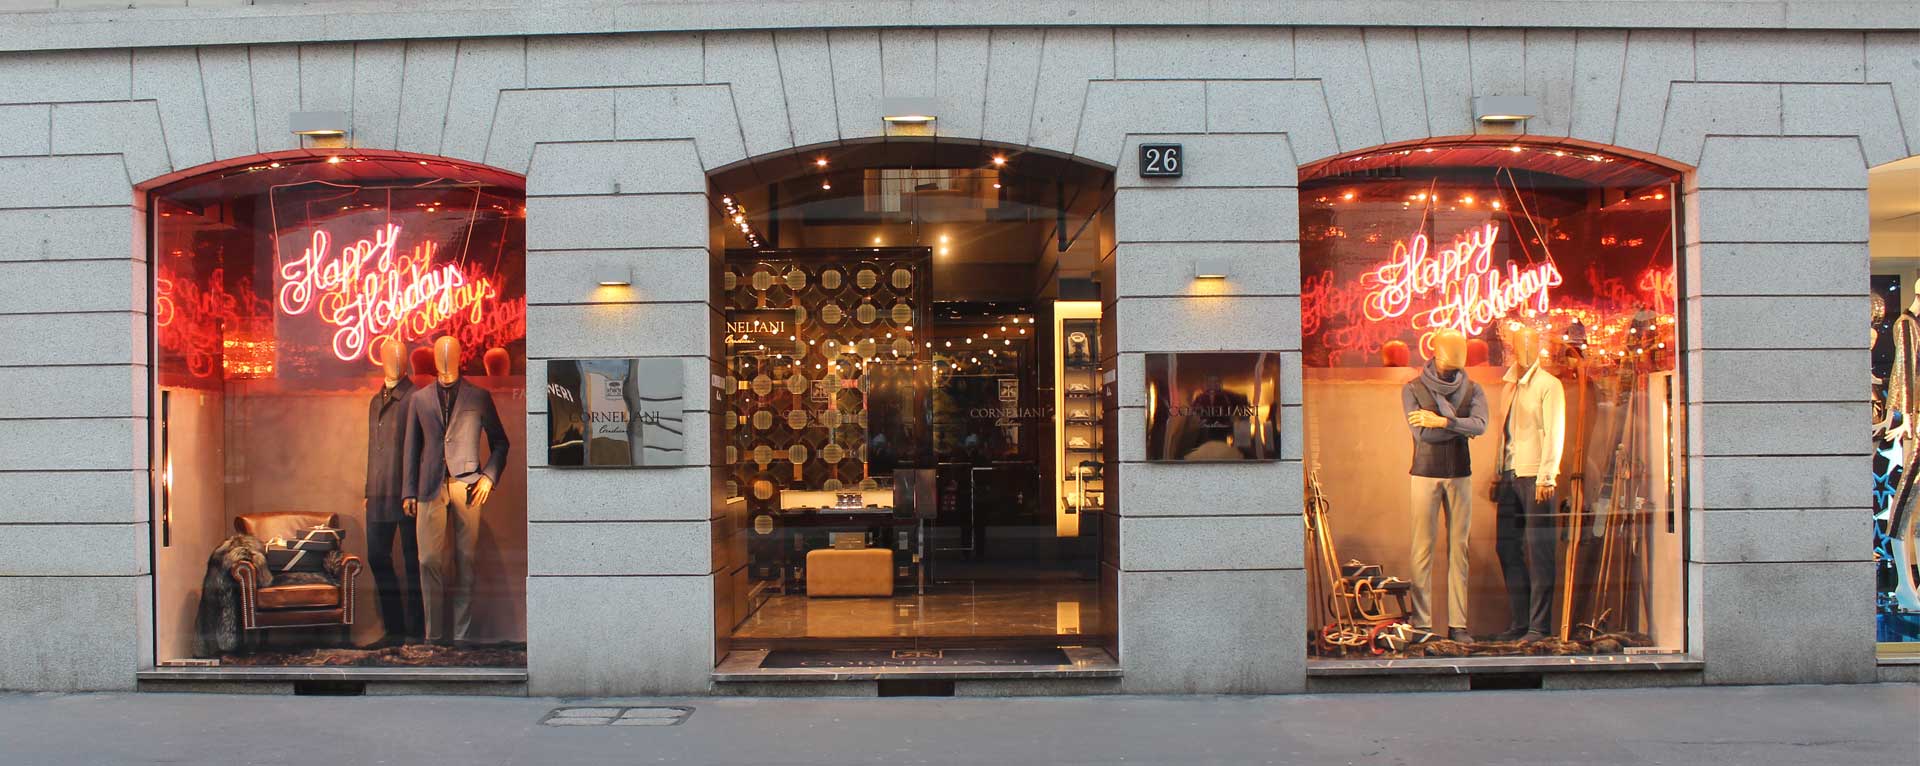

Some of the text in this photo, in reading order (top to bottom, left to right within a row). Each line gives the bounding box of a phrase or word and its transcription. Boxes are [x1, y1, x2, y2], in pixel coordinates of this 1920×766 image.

[1146, 149, 1177, 171] 26
[280, 223, 400, 315] Happy
[333, 262, 464, 361] Holidays
[1377, 223, 1499, 318] Happy
[1428, 261, 1563, 339] Holidays
